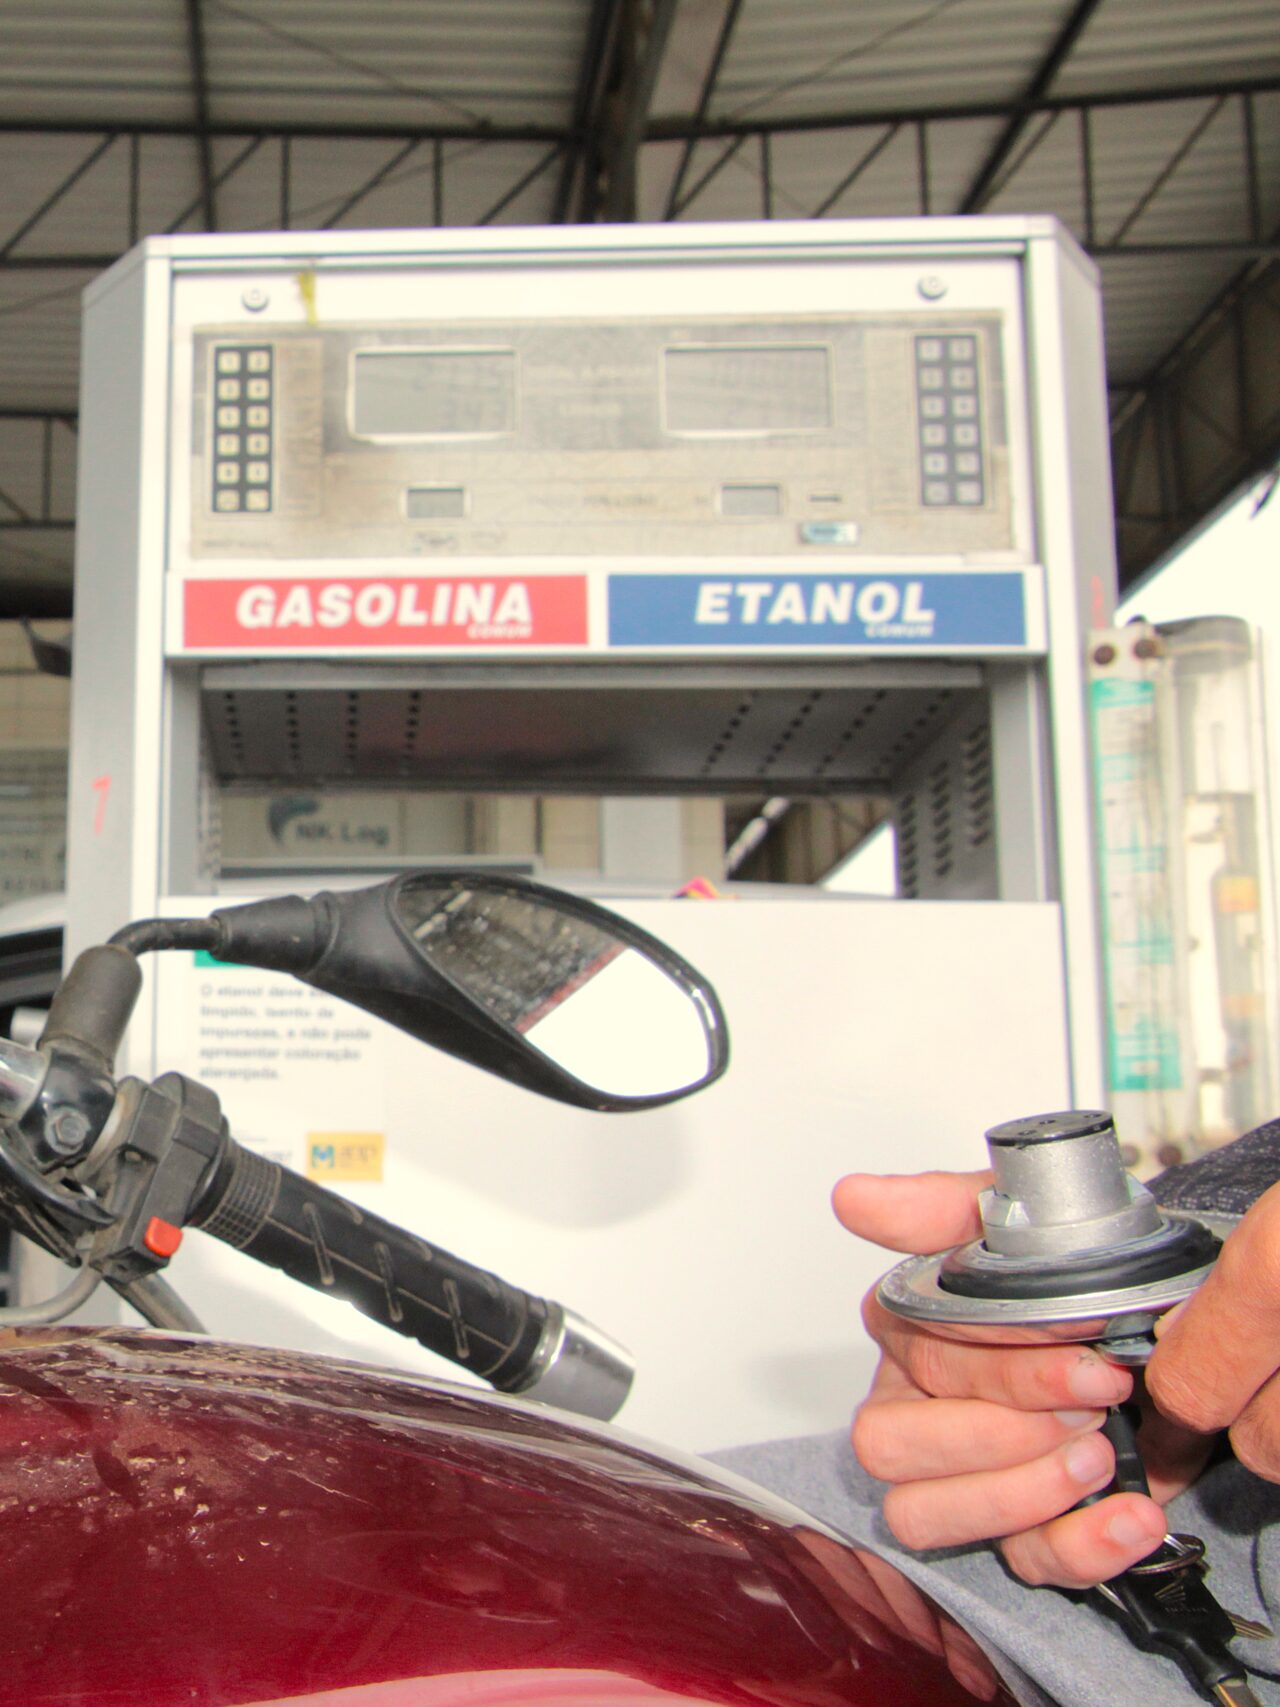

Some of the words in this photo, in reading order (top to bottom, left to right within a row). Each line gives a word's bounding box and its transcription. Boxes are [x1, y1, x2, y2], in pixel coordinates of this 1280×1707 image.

[235, 582, 533, 628] GASOLINA
[693, 580, 937, 625] ETANOL
[217, 985, 263, 998] etanol
